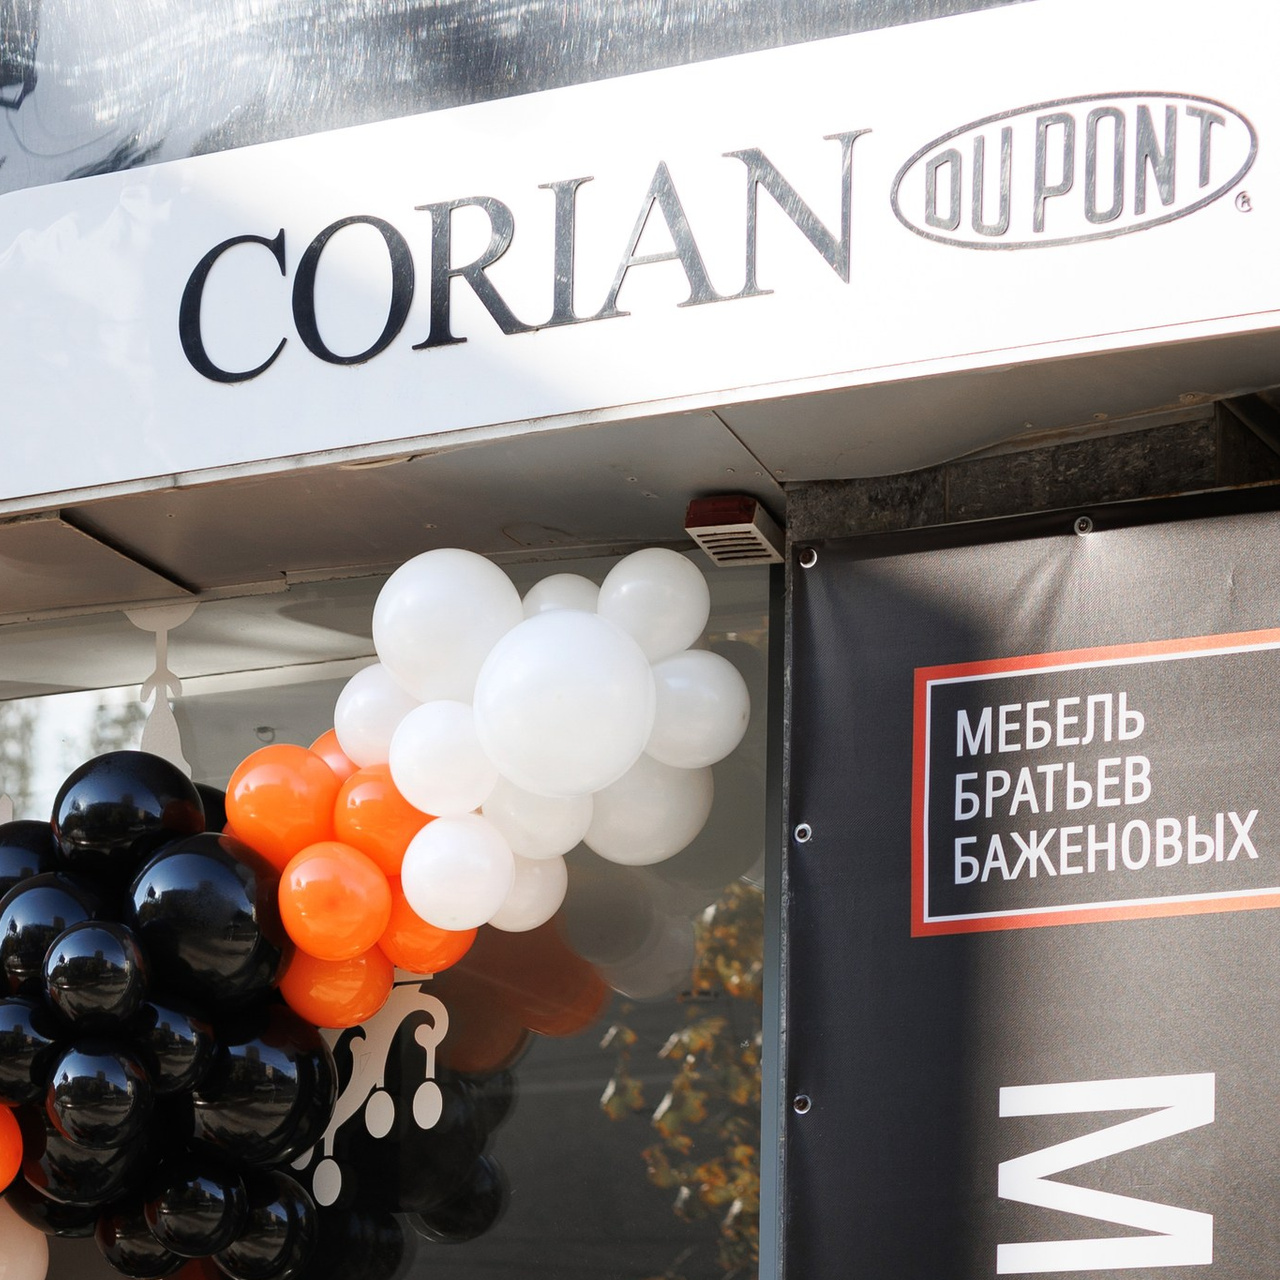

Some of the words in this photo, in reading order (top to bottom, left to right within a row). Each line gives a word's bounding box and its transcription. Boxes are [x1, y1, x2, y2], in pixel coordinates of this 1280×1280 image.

[179, 128, 874, 383] CORIAN
[956, 692, 1145, 757] МЕБЕЛЬ
[954, 755, 1152, 821] БРАТЬЕВ
[954, 809, 1259, 885] БАЖЕНОВЫХ
